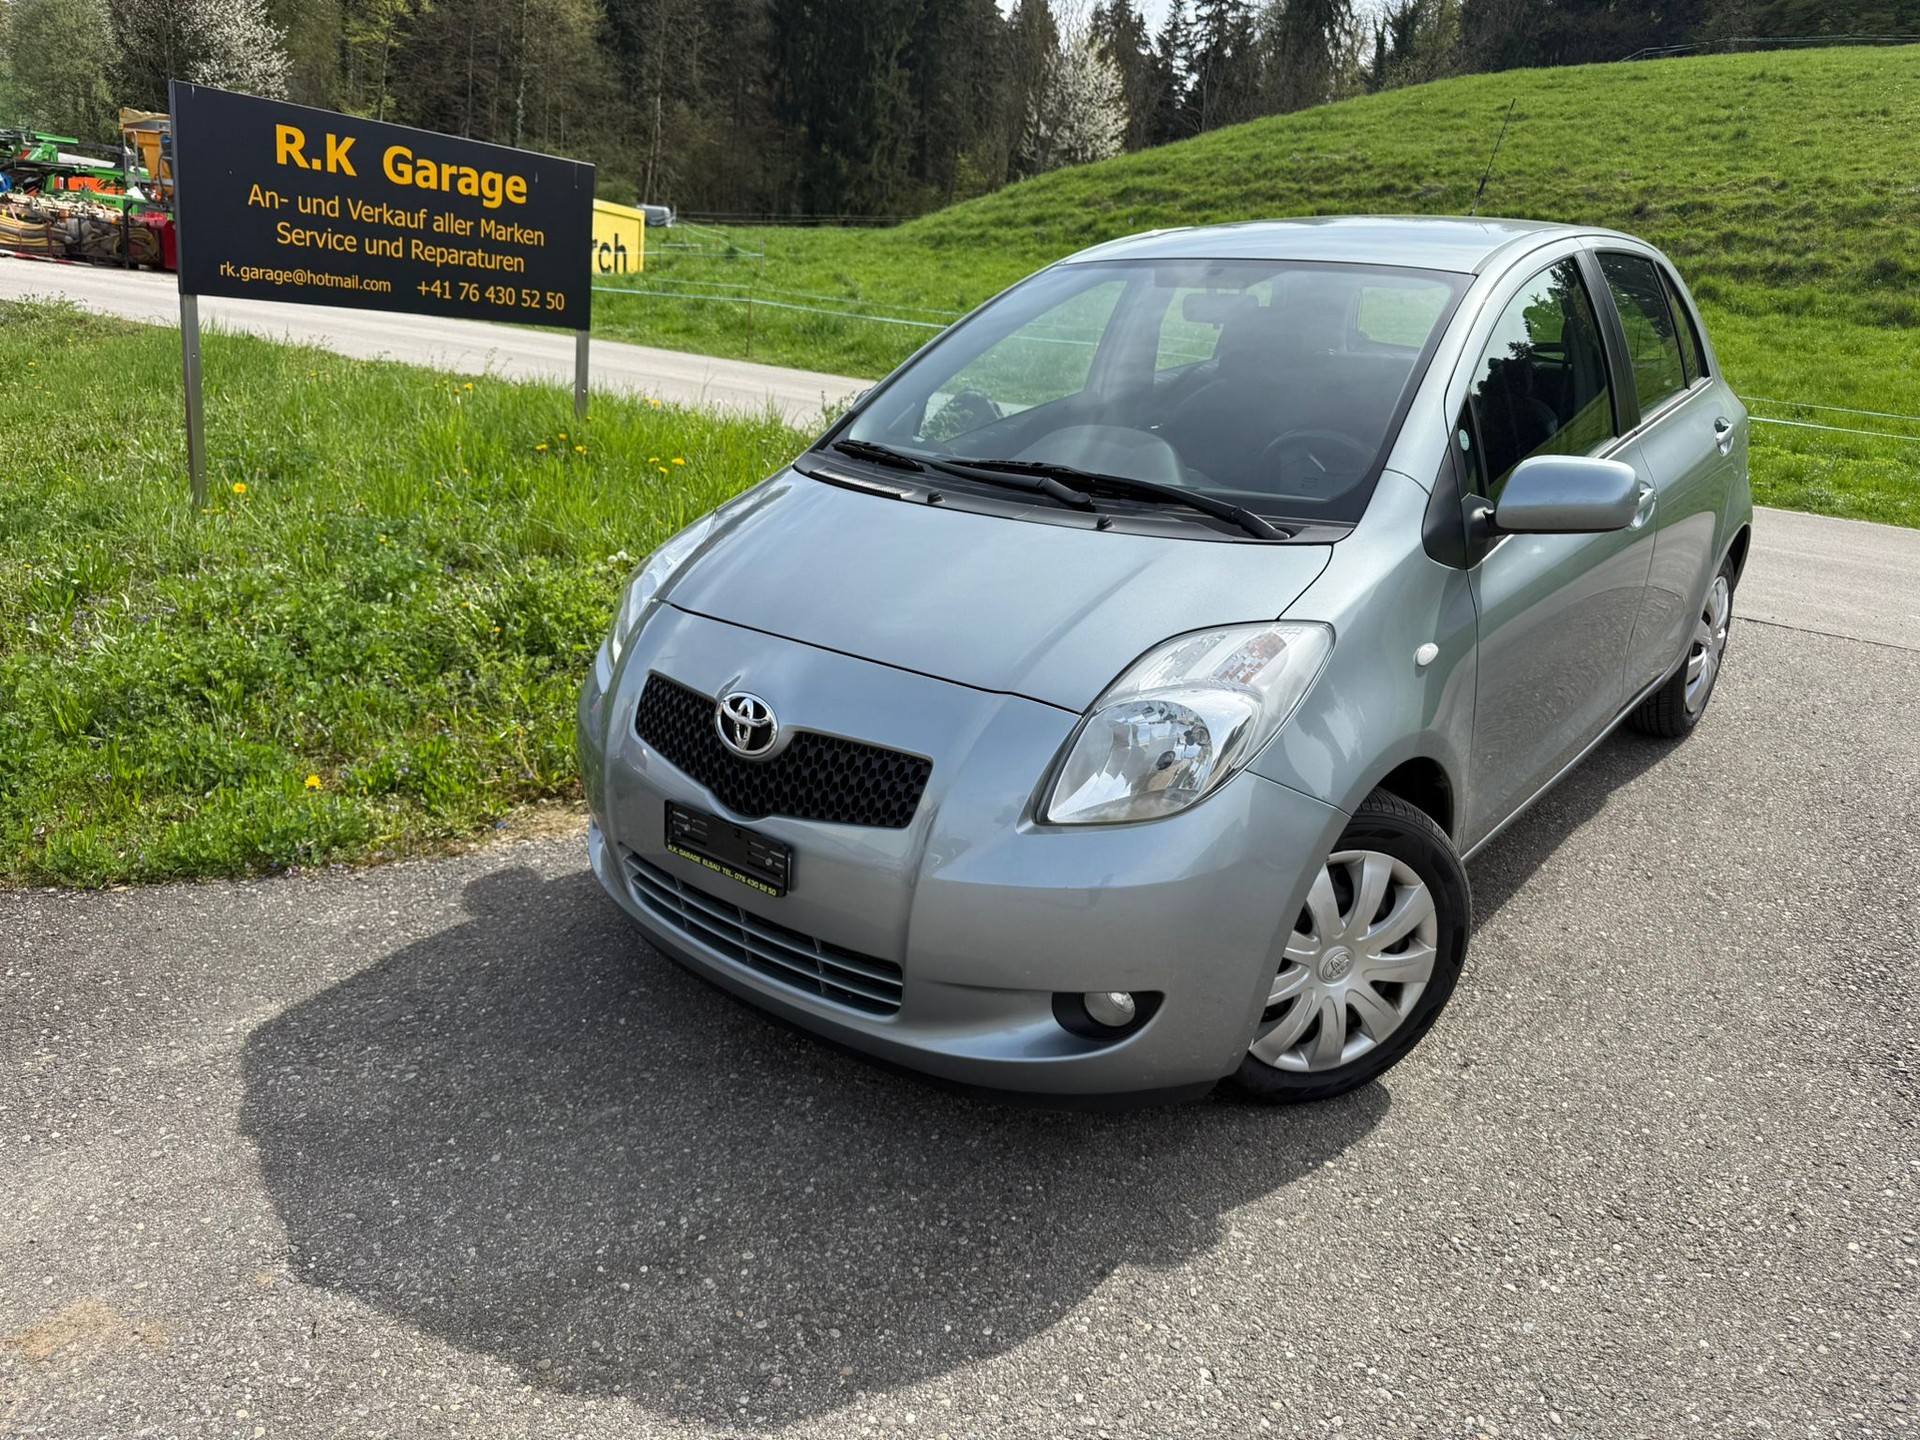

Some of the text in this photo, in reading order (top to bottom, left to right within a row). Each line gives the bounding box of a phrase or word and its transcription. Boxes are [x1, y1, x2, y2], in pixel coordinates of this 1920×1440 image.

[275, 123, 528, 209] R.K Garage
[248, 184, 545, 246] An- und Verkauf aller Marken
[276, 221, 525, 273] Service und Reparaturen
[219, 261, 391, 293] rk.garage@hotmail.com
[416, 280, 565, 311] +41 76 430 52 50
[679, 849, 701, 863] GARAGE
